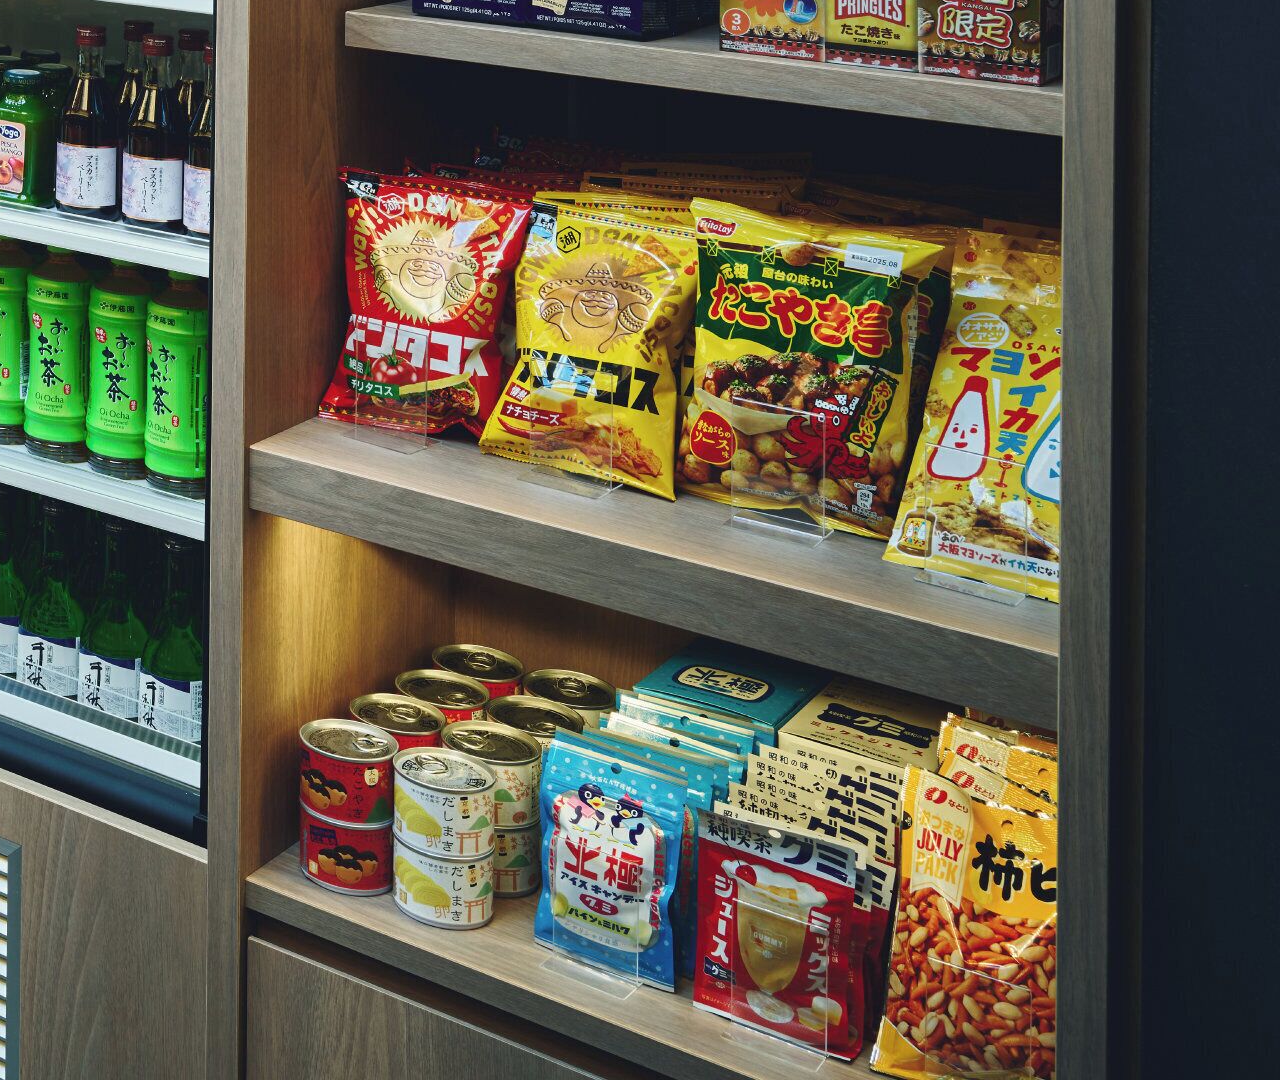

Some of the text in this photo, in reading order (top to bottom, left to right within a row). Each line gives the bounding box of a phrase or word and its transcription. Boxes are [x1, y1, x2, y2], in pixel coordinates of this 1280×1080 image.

[962, 2, 992, 11] KANSAI
[733, 14, 741, 25] 3
[942, 8, 1006, 43] 限定
[841, 23, 900, 40] たこ焼き味
[0, 125, 19, 138] Yoga
[1, 141, 17, 149] PESCA
[1, 147, 22, 156] MANGO
[408, 192, 461, 221] DON
[867, 256, 898, 268] 2025.08
[762, 268, 834, 289] 屋台の味わい
[708, 273, 893, 358] たこやき亭
[962, 322, 1006, 331] オオサカ
[346, 314, 490, 377] ドンタコス
[1012, 341, 1060, 354] OSAK
[951, 347, 1061, 380] マヨソ
[351, 379, 393, 397] チリタコス
[506, 404, 559, 425] ナチョチーズ
[995, 384, 1047, 456] イカ天
[769, 752, 809, 770] 昭和の味
[757, 762, 796, 782] 昭和の味
[974, 784, 995, 800] なとり
[948, 799, 968, 813] なとり
[442, 796, 456, 852] だしまき
[708, 821, 849, 885] 純喫茶 グミ
[917, 828, 963, 862] JOLLY
[564, 835, 644, 893] 北極
[916, 852, 958, 884] PACK
[451, 866, 464, 922] だしまき
[711, 874, 733, 964] ジュース
[753, 932, 783, 947] GUMMY
[806, 911, 832, 994] ミックス
